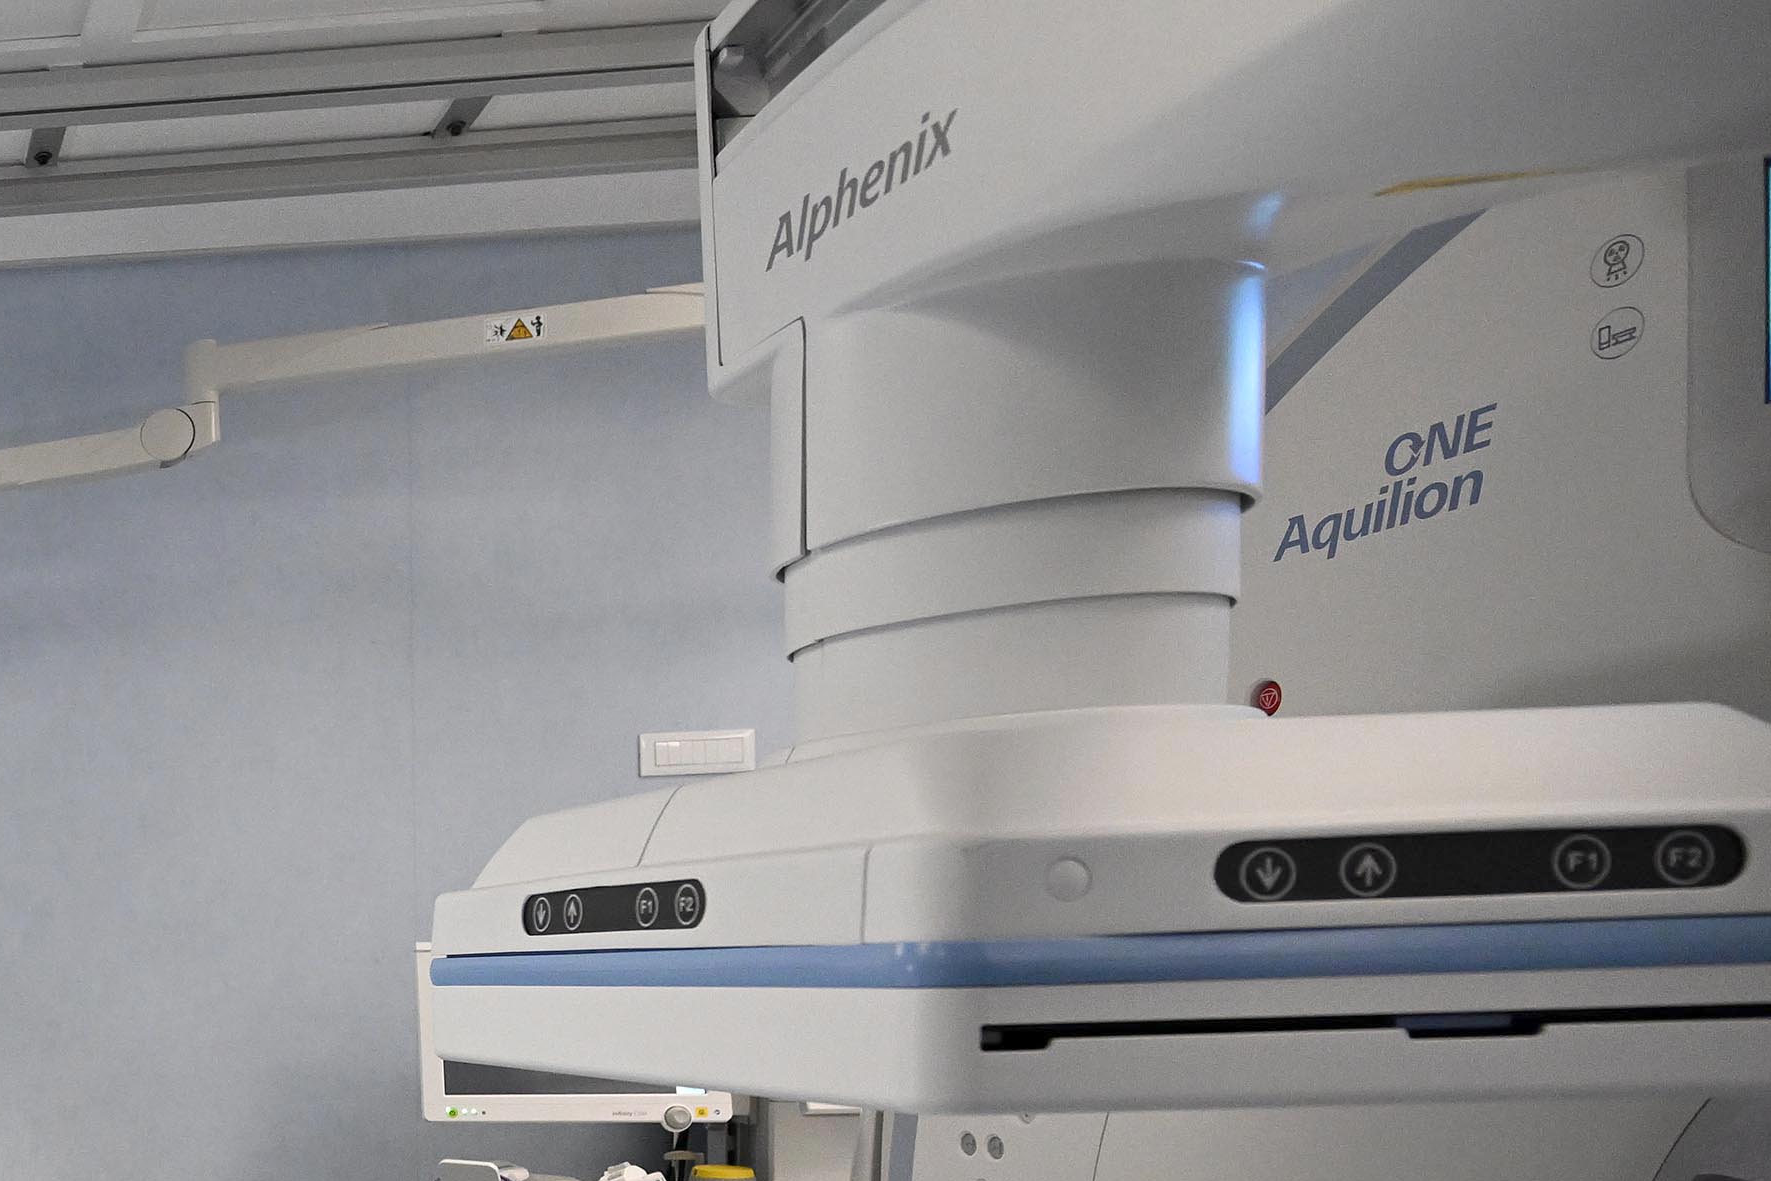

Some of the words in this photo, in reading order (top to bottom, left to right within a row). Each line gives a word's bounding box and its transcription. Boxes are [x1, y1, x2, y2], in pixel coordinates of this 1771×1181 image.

[765, 108, 959, 273] Alphenix
[1384, 402, 1498, 477] ONE
[1273, 469, 1484, 563] Aquilion
[1568, 852, 1598, 873] F1
[1669, 848, 1703, 868] F2
[640, 899, 653, 914] F1
[679, 896, 694, 912] F2
